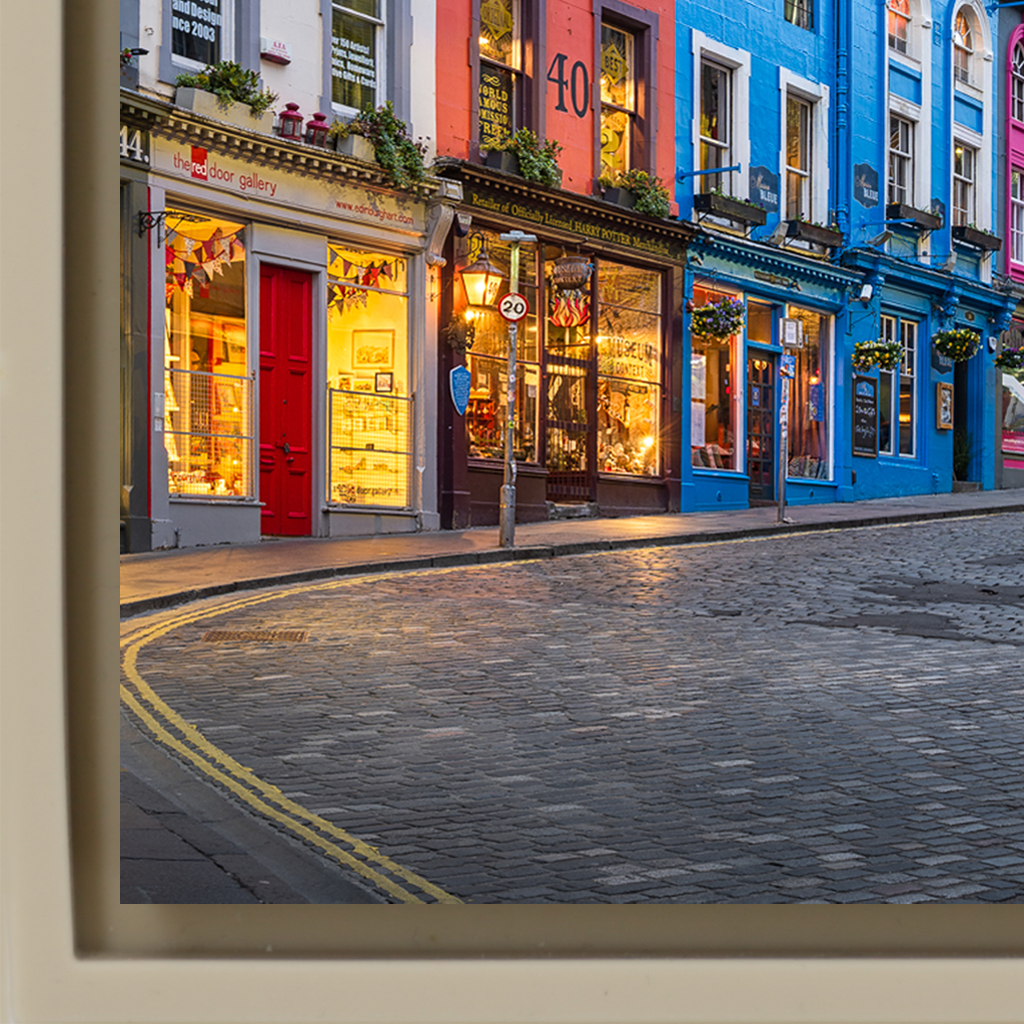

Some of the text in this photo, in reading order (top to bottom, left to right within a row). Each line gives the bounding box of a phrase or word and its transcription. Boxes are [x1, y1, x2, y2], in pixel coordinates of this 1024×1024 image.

[191, 1, 222, 26] Design
[172, 16, 215, 42] nce 2003
[604, 55, 622, 73] BEST
[547, 53, 589, 118] 40
[174, 152, 277, 196] the red door gallery
[760, 189, 778, 204] BLEUE
[864, 187, 878, 202] BLEUE
[501, 202, 510, 213] of
[575, 221, 600, 237] HARRY
[601, 228, 630, 245] POTTER
[503, 300, 525, 314] 20
